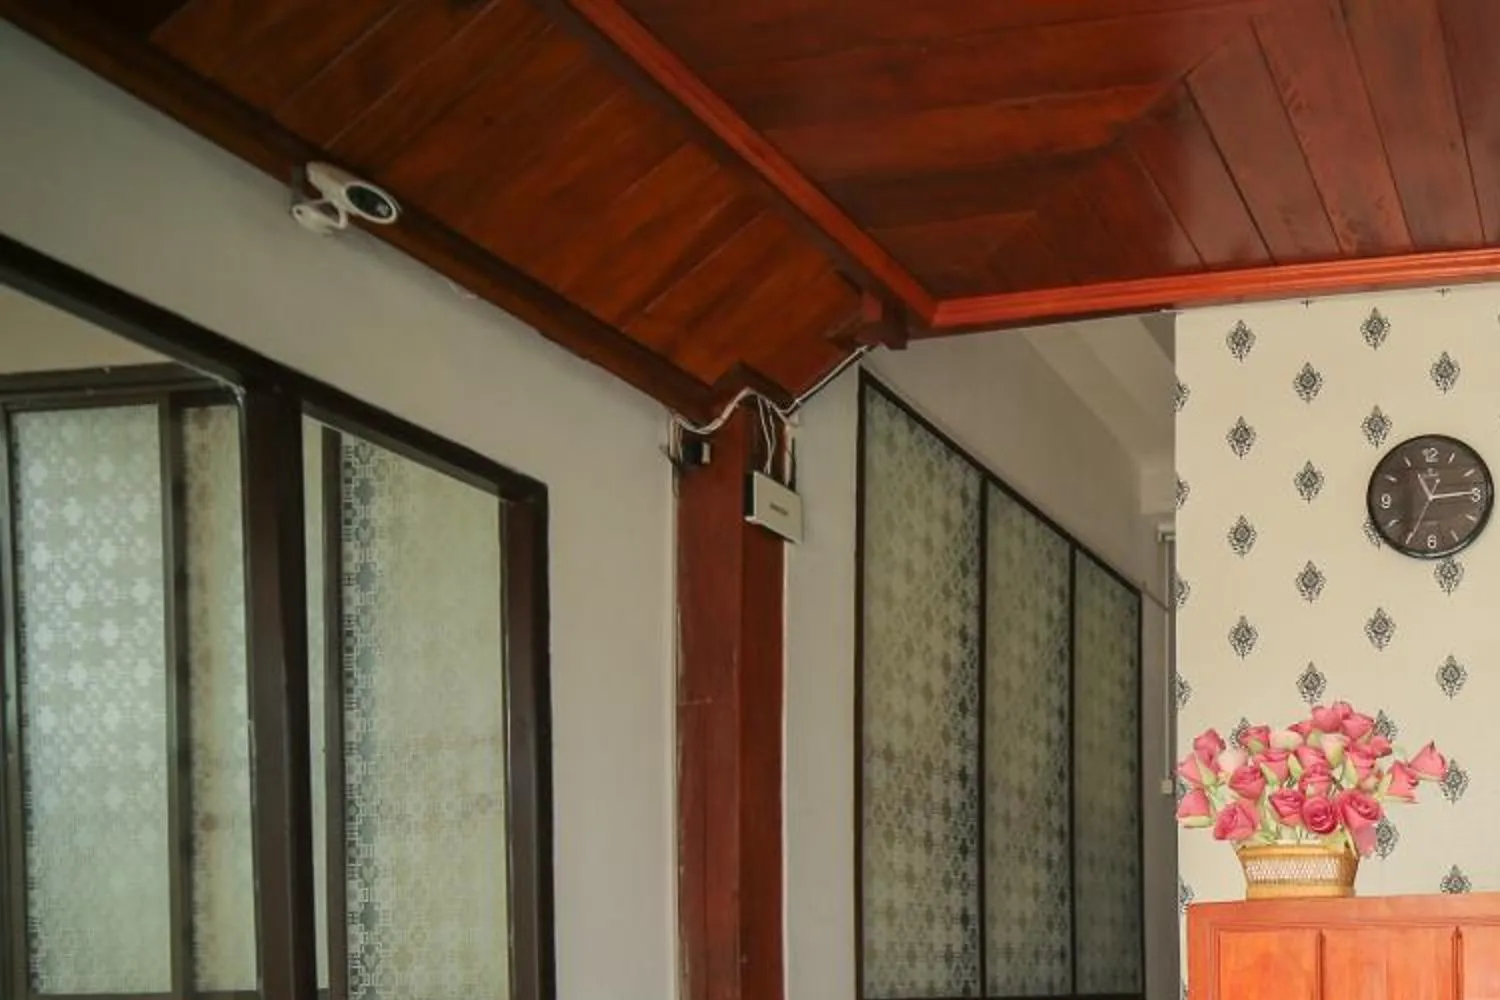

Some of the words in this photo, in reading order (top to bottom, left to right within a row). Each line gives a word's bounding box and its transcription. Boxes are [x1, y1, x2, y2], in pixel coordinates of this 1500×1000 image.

[1422, 447, 1439, 463] 12
[1381, 493, 1392, 508] 9
[1427, 534, 1437, 549] 6
